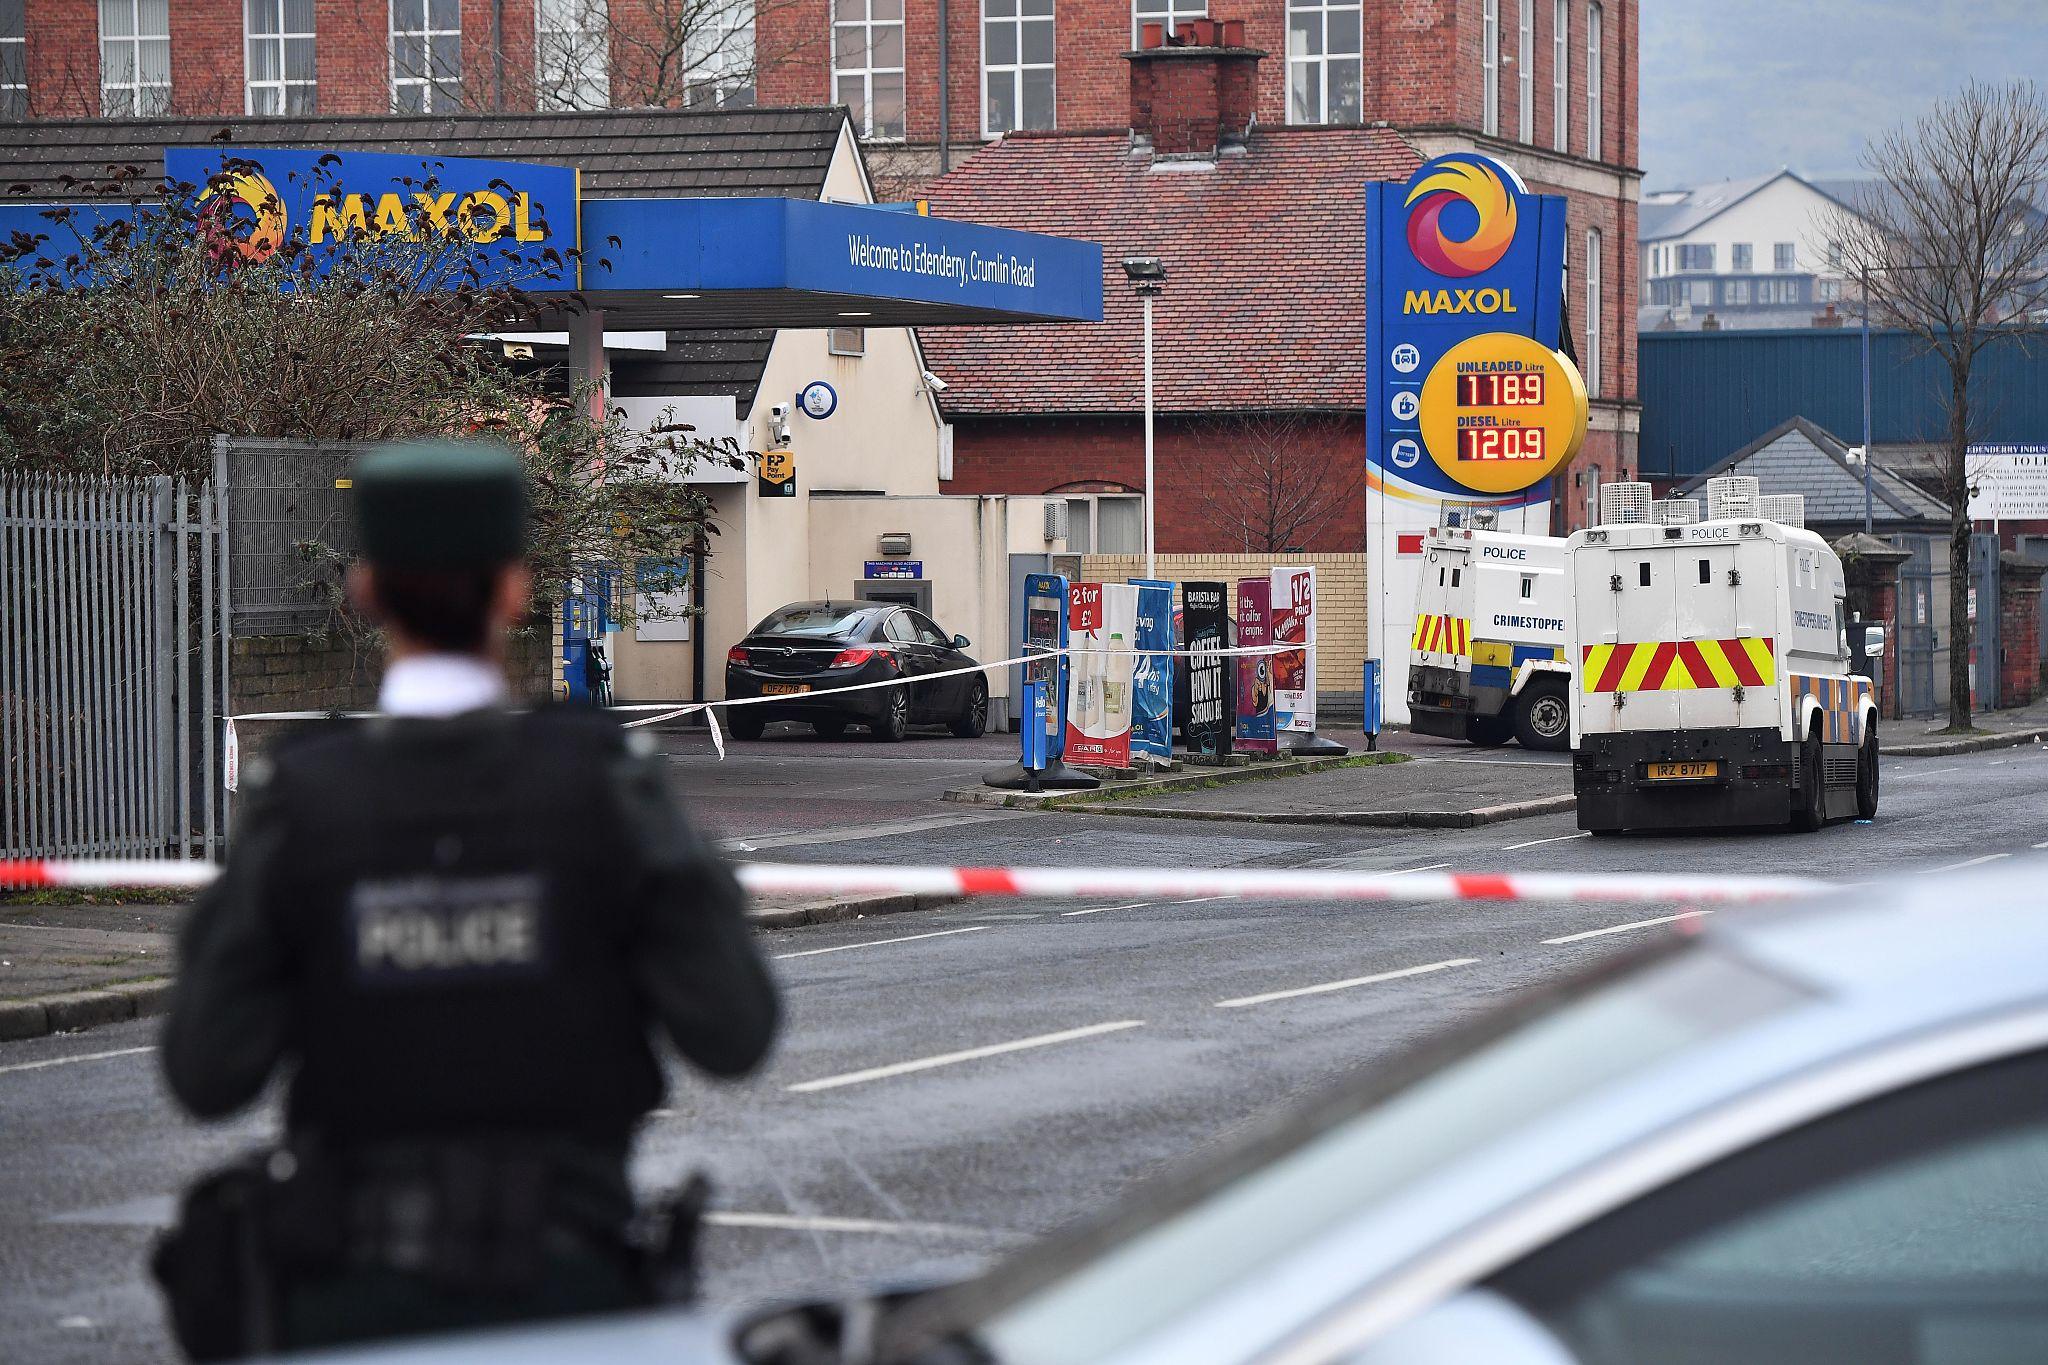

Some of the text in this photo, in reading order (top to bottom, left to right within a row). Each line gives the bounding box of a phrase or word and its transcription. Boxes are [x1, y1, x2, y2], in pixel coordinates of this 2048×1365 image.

[310, 190, 544, 244] MAXOL
[848, 234, 1035, 288] Welcome to Edenderry, Crumlin Road
[1403, 287, 1517, 314] MAXOL
[1456, 361, 1544, 373] UNLEADED Litre
[1457, 416, 1520, 427] DIESEL Litre
[2020, 445, 2048, 454] INDUS
[1691, 528, 1730, 540] POLICE
[1483, 546, 1526, 560] POLICE
[1072, 587, 1098, 605] 2 for
[1187, 591, 1210, 603] BARISTA
[1292, 575, 1310, 605] 1/2
[1081, 610, 1092, 626] £2
[1493, 614, 1564, 631] CRIMESTOPPE
[1245, 625, 1263, 638] engine
[1190, 636, 1221, 670] COFFEE
[767, 684, 804, 694] OFZ178
[1190, 667, 1221, 703] HOW IT
[1191, 701, 1214, 724] SHOULD
[1657, 763, 1707, 777] IRZ 8717
[357, 902, 540, 968] POLICE
